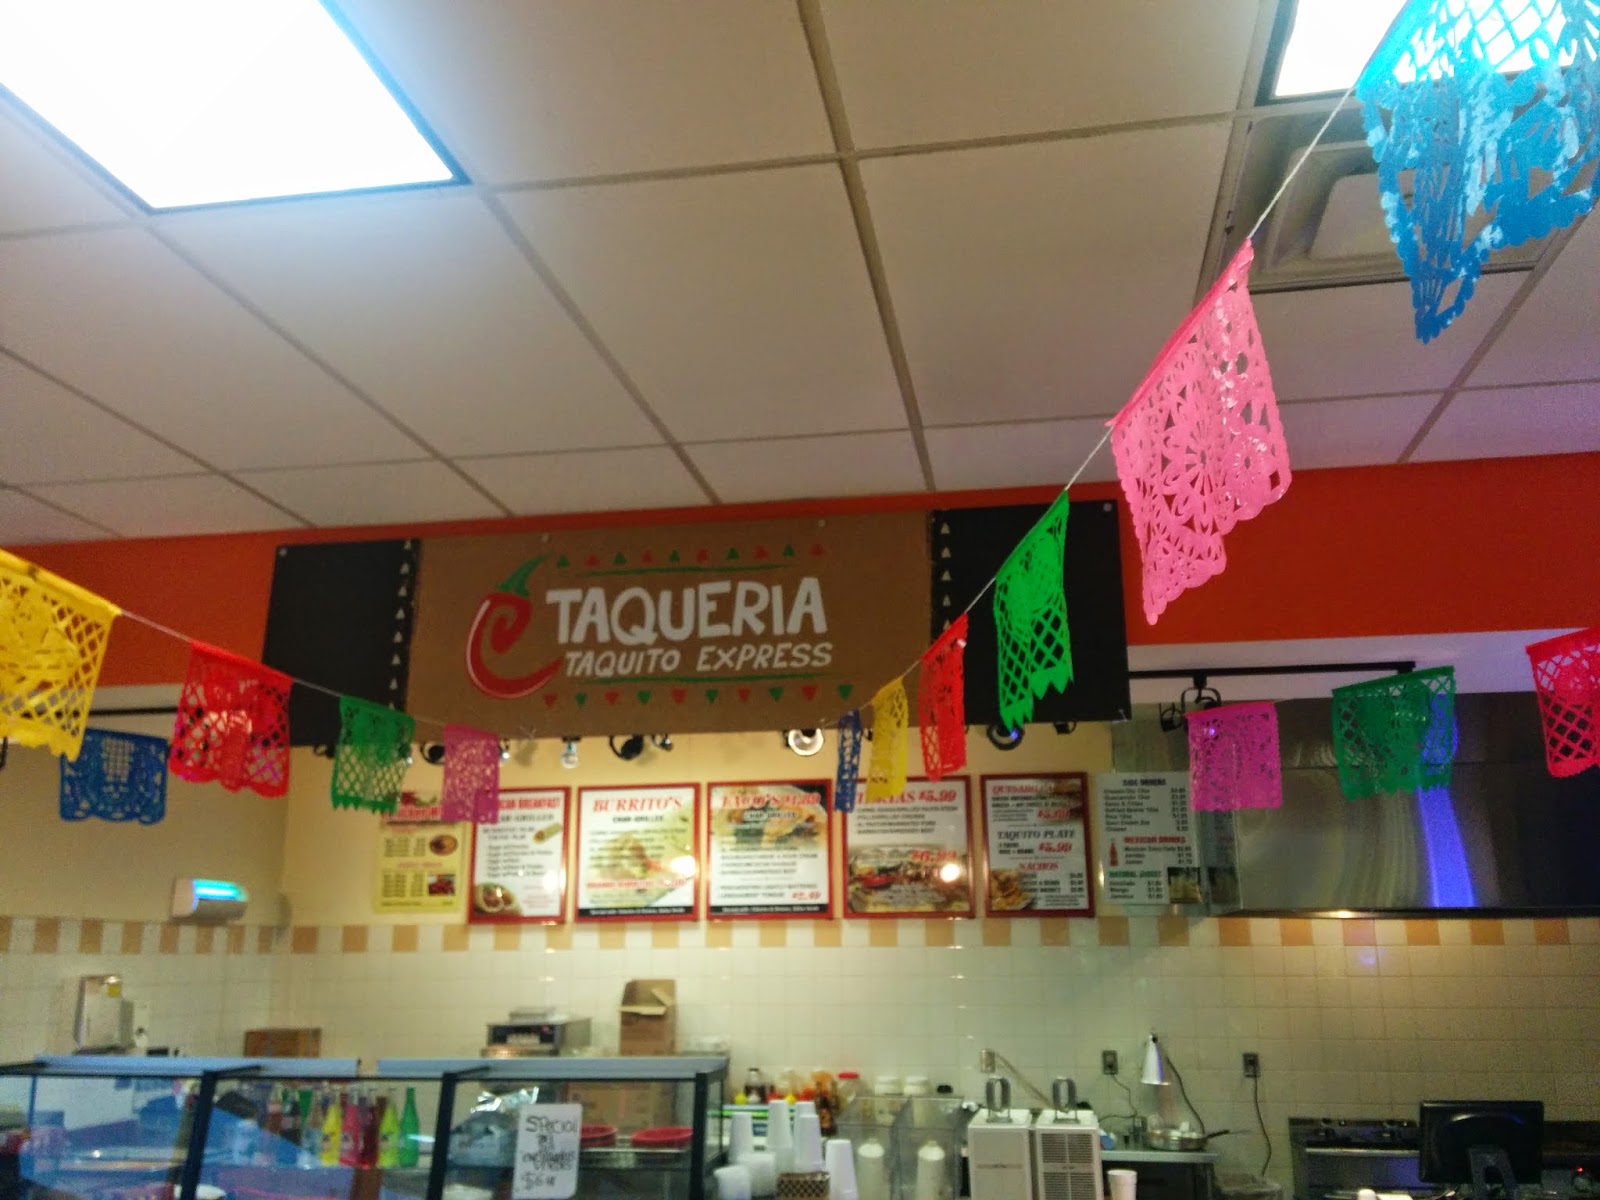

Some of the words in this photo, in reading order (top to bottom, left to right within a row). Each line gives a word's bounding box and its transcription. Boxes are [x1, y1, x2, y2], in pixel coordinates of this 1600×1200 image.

[545, 577, 828, 646] TAQUERIA
[565, 648, 681, 678] TAQUITO
[695, 641, 834, 673] EXPRESS
[997, 830, 1041, 841] TAQUITO
